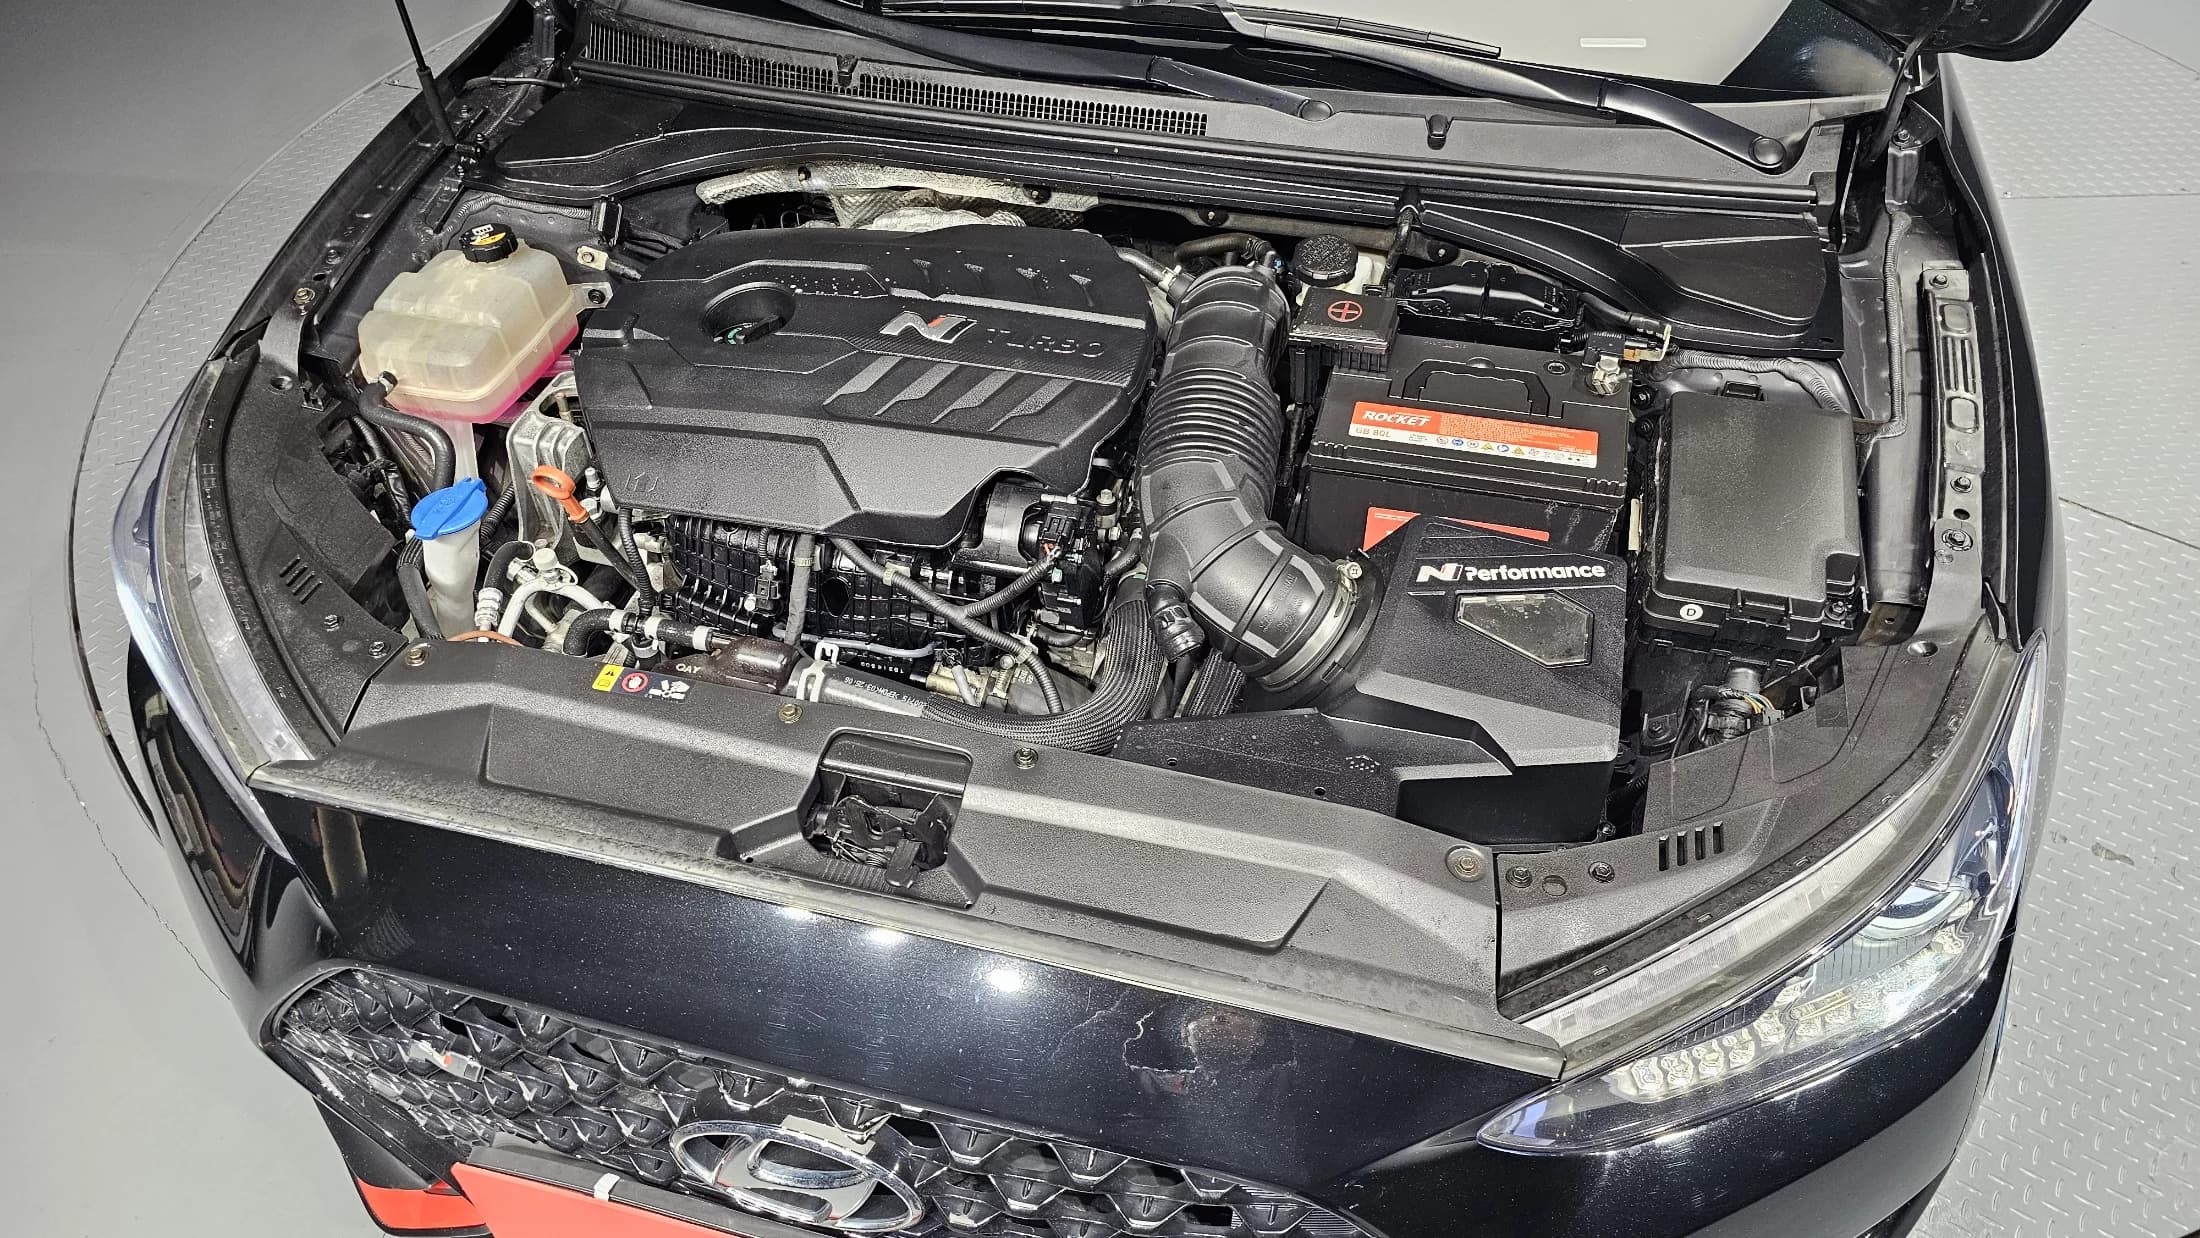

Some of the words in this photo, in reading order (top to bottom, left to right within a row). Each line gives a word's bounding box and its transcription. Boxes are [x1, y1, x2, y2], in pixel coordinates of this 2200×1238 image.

[1362, 410, 1431, 427] ROCKET
[1416, 562, 1463, 582] N
[1465, 564, 1606, 582] Performance
